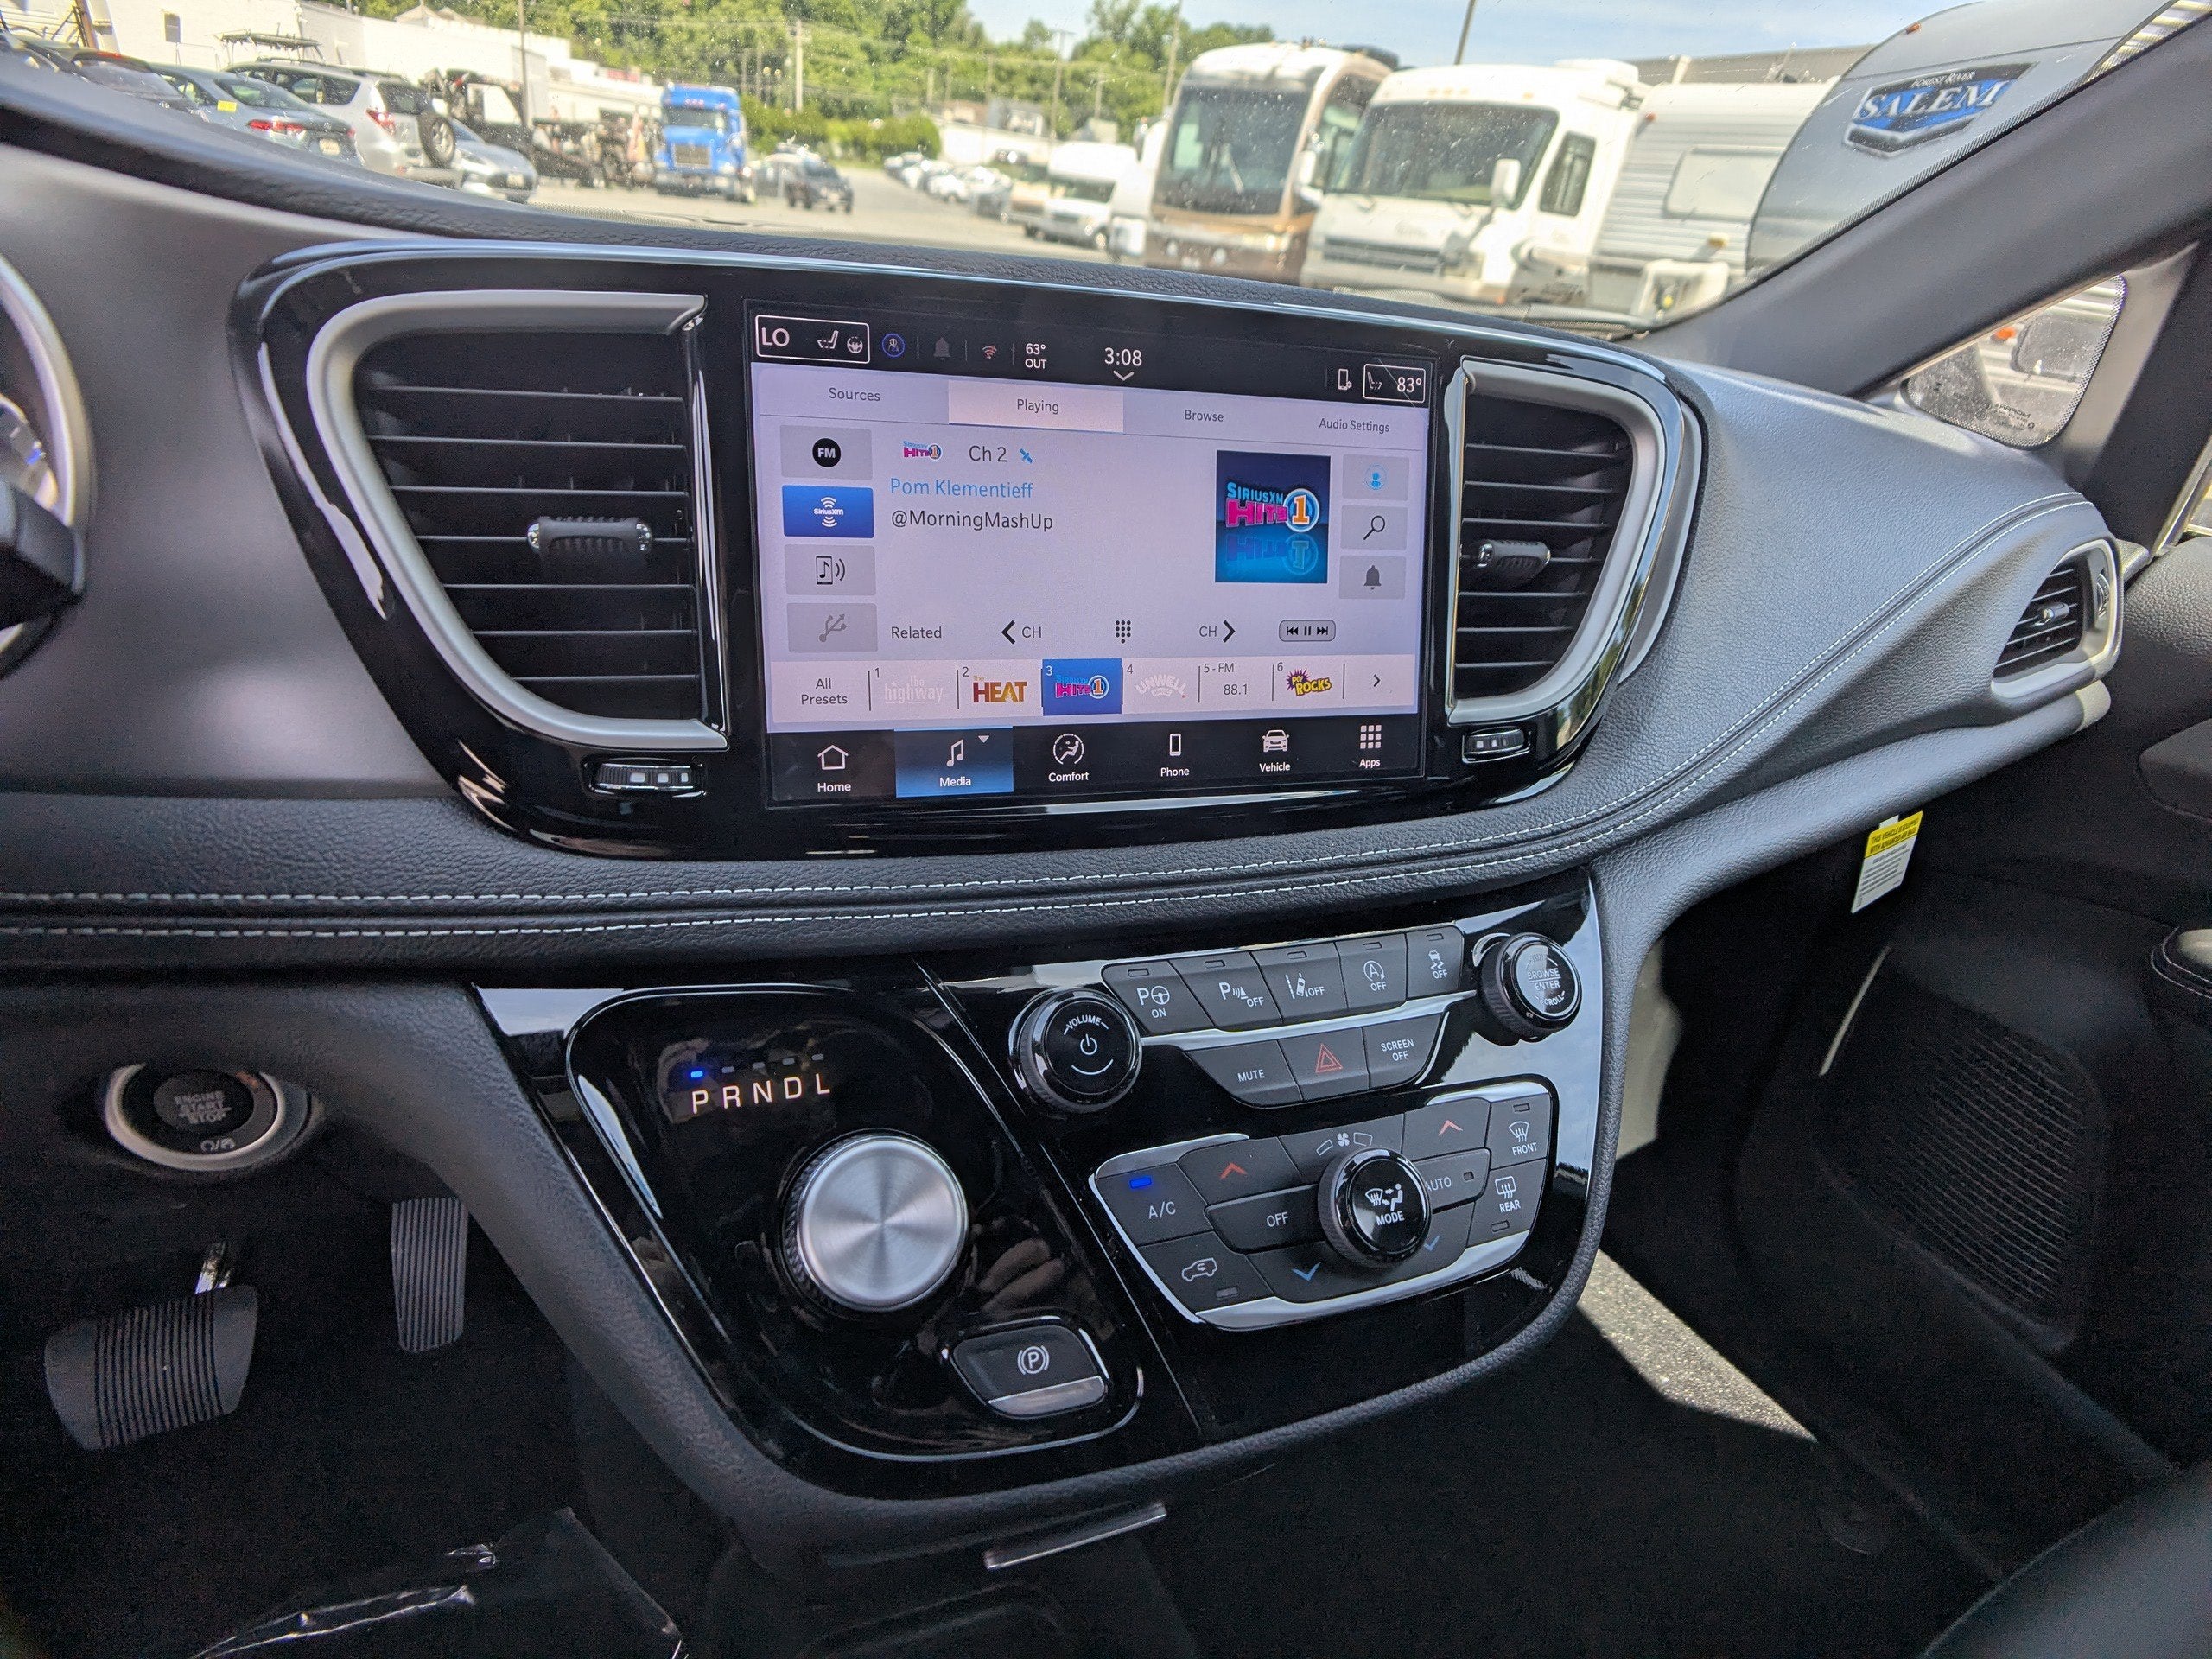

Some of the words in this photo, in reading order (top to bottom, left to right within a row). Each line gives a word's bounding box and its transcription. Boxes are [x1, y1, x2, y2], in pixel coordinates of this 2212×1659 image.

[1861, 81, 2009, 118] SALEM
[761, 327, 790, 347] LO
[1026, 343, 1046, 355] 63°
[1104, 347, 1142, 366] 3:08
[1025, 359, 1047, 369] OUT
[1396, 376, 1422, 392] 83°
[828, 387, 880, 402] Sources
[1017, 398, 1059, 415] Playing
[1185, 409, 1224, 423] Browse
[1319, 418, 1347, 431] Audio
[1350, 420, 1389, 435] Settings
[817, 448, 836, 459] FM
[969, 445, 992, 462] Ch
[996, 446, 1007, 463] 2
[891, 478, 930, 495] Pom
[935, 480, 1033, 499] Klementieff
[1226, 498, 1288, 527] HITS
[892, 510, 1053, 531] @MorningMashUp
[891, 626, 943, 639] Related
[1022, 626, 1042, 639] CH
[1198, 625, 1217, 638] CH
[874, 668, 880, 678] 1
[962, 667, 969, 677] 2
[1046, 665, 1053, 676] 3
[1126, 664, 1134, 674] 4
[1204, 663, 1210, 673] 5
[1217, 663, 1234, 672] FM
[1277, 662, 1283, 672] 6
[816, 678, 832, 690] All
[1135, 674, 1186, 694] UNWELL
[1224, 683, 1248, 696] 88.1
[1296, 678, 1331, 696] ROCKS
[801, 693, 848, 705] Presets
[884, 683, 944, 703] highway
[973, 682, 1027, 703] HEAT
[1260, 761, 1291, 772] Vehicle
[1359, 758, 1381, 770] Apps
[1048, 770, 1090, 782] Comfort
[1160, 766, 1190, 777] Phone
[817, 781, 851, 792] Home
[939, 777, 972, 787] Media
[1433, 969, 1448, 980] OFF
[1528, 968, 1560, 980] BROWSE
[1219, 982, 1230, 1000] P
[1308, 986, 1325, 997] OFF
[1370, 981, 1386, 992] OFF
[1535, 980, 1560, 991] ENTER
[1136, 987, 1149, 1006] P
[1246, 996, 1264, 1007] OFF
[1151, 1007, 1166, 1018] ON
[1066, 1014, 1102, 1031] VOLUME
[1381, 1039, 1414, 1052] SCREEN
[1392, 1050, 1408, 1061] OFF
[1237, 1069, 1265, 1083] MUTE
[692, 1090, 709, 1114] P
[722, 1085, 741, 1109] R
[753, 1080, 772, 1104] N
[784, 1077, 802, 1100] D
[816, 1073, 830, 1095] L
[1511, 1142, 1537, 1156] FRONT
[1426, 1177, 1452, 1192] AUTO
[1148, 1201, 1176, 1219] A/C
[1499, 1200, 1521, 1214] REAR
[1267, 1212, 1288, 1227] OFF
[1376, 1211, 1405, 1226] MODE
